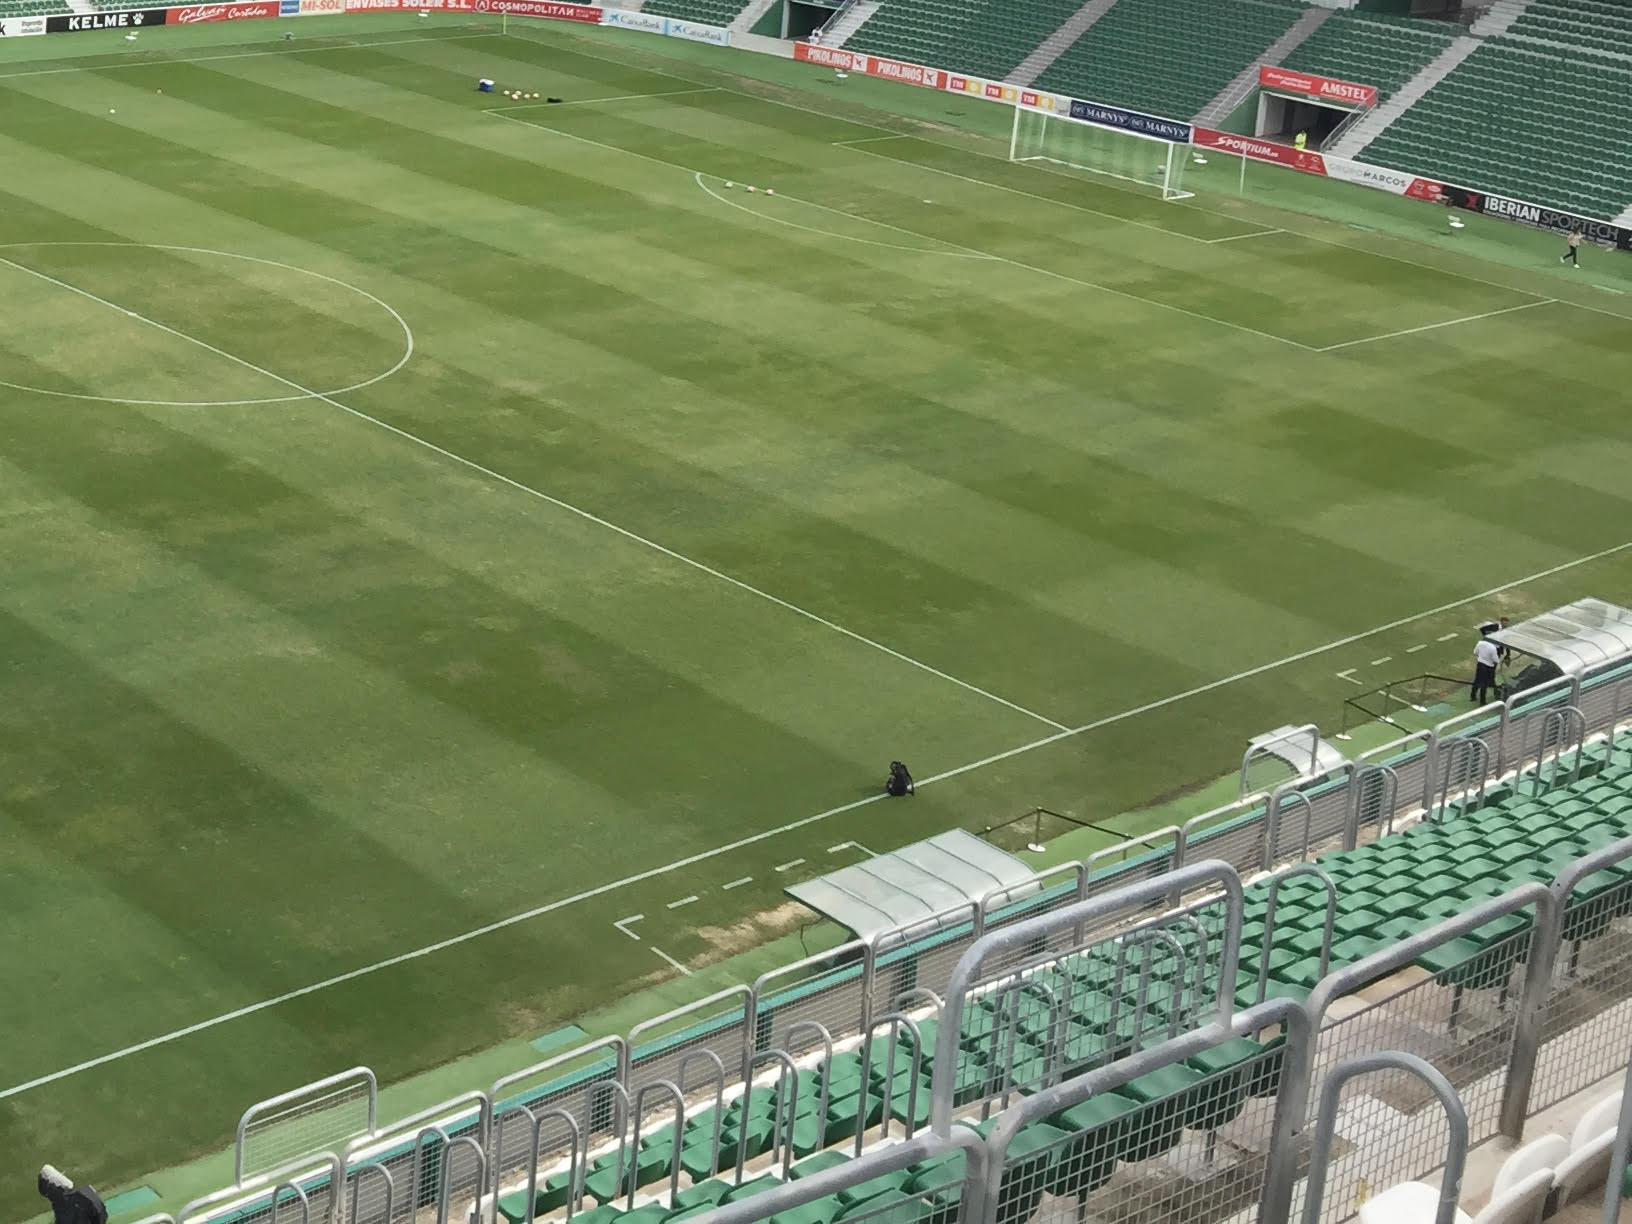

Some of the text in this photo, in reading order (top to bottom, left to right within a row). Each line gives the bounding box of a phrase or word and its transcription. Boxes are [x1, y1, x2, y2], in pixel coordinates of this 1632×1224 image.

[491, 1, 574, 16] COSMOPOLITAN
[68, 14, 129, 30] KELME
[808, 46, 852, 69] PIKOLINOS
[877, 60, 922, 82] PIKOLINOS
[1320, 81, 1369, 100] AMSTEL
[1086, 107, 1125, 123] MARNYS
[1146, 121, 1185, 138] MARNYS
[1484, 197, 1541, 222] IBERIAN
[1541, 211, 1619, 240] SPORTECH
